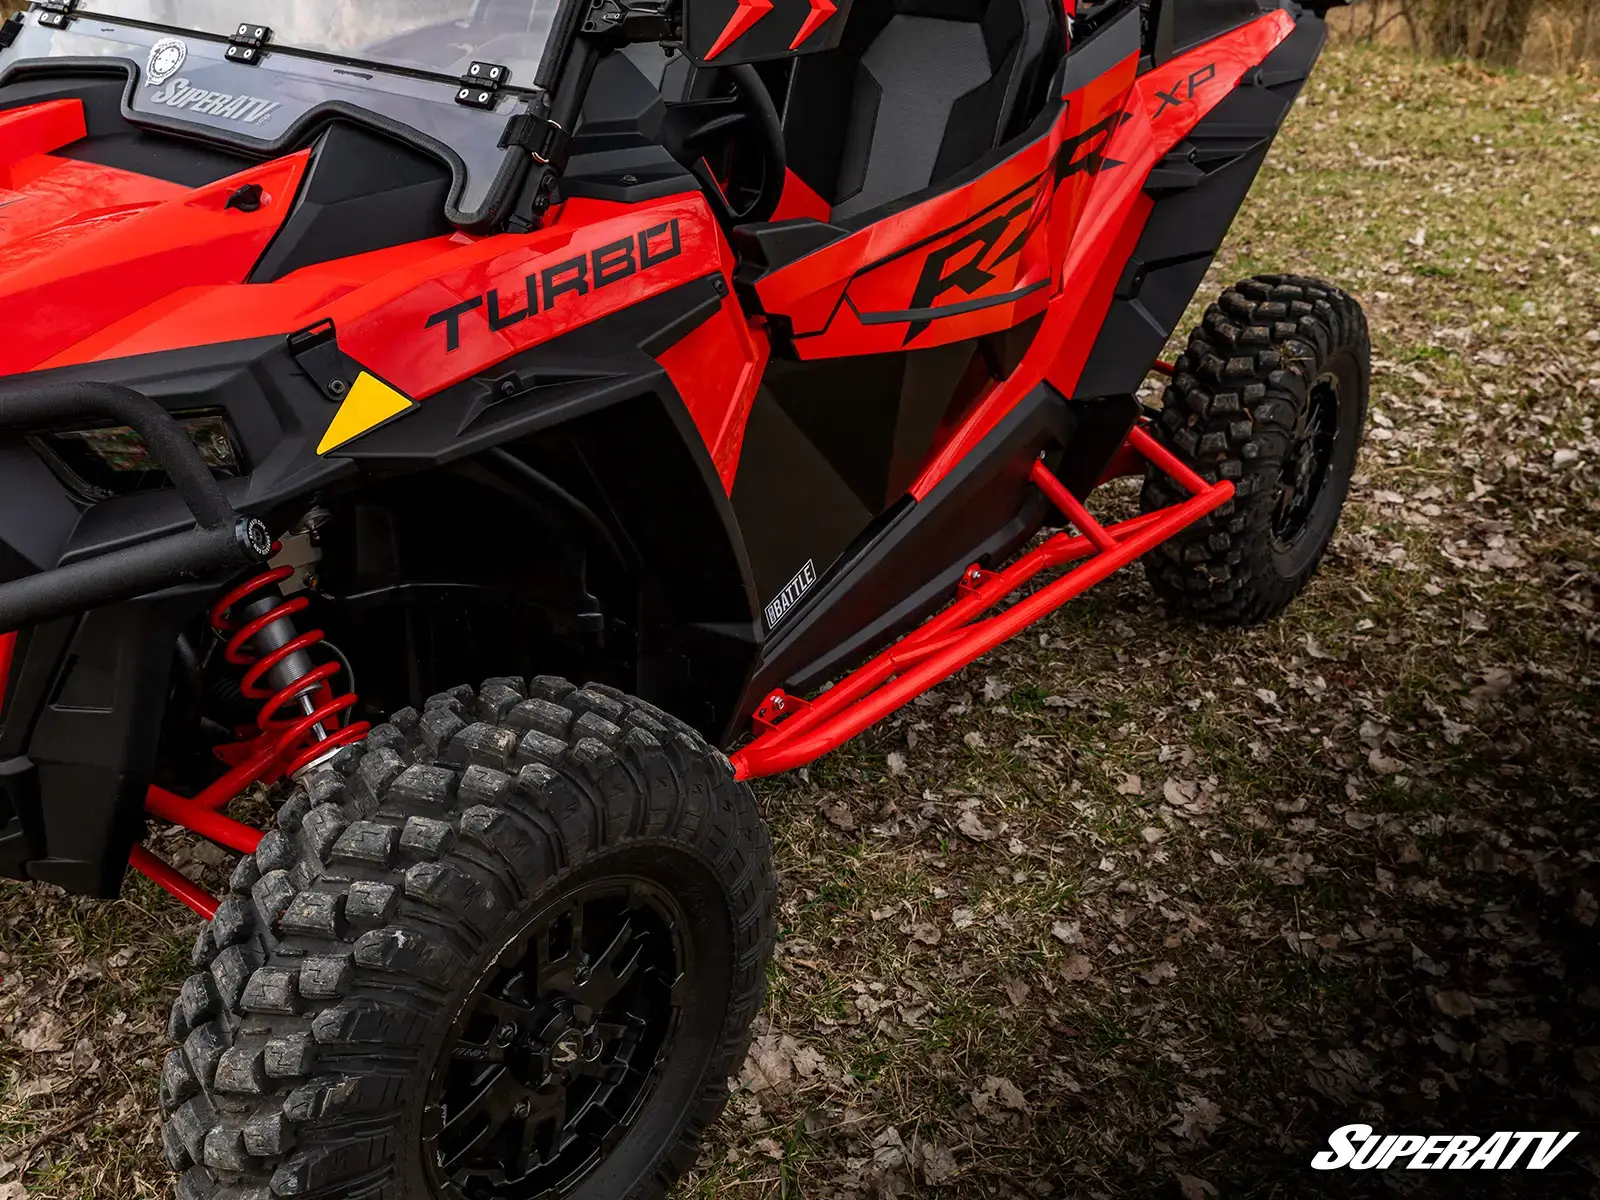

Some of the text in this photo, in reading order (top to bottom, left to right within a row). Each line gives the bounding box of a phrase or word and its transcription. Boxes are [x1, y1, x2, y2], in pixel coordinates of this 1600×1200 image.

[1151, 62, 1216, 120] XP
[423, 218, 682, 353] TURBO
[773, 563, 813, 618] BATTLE
